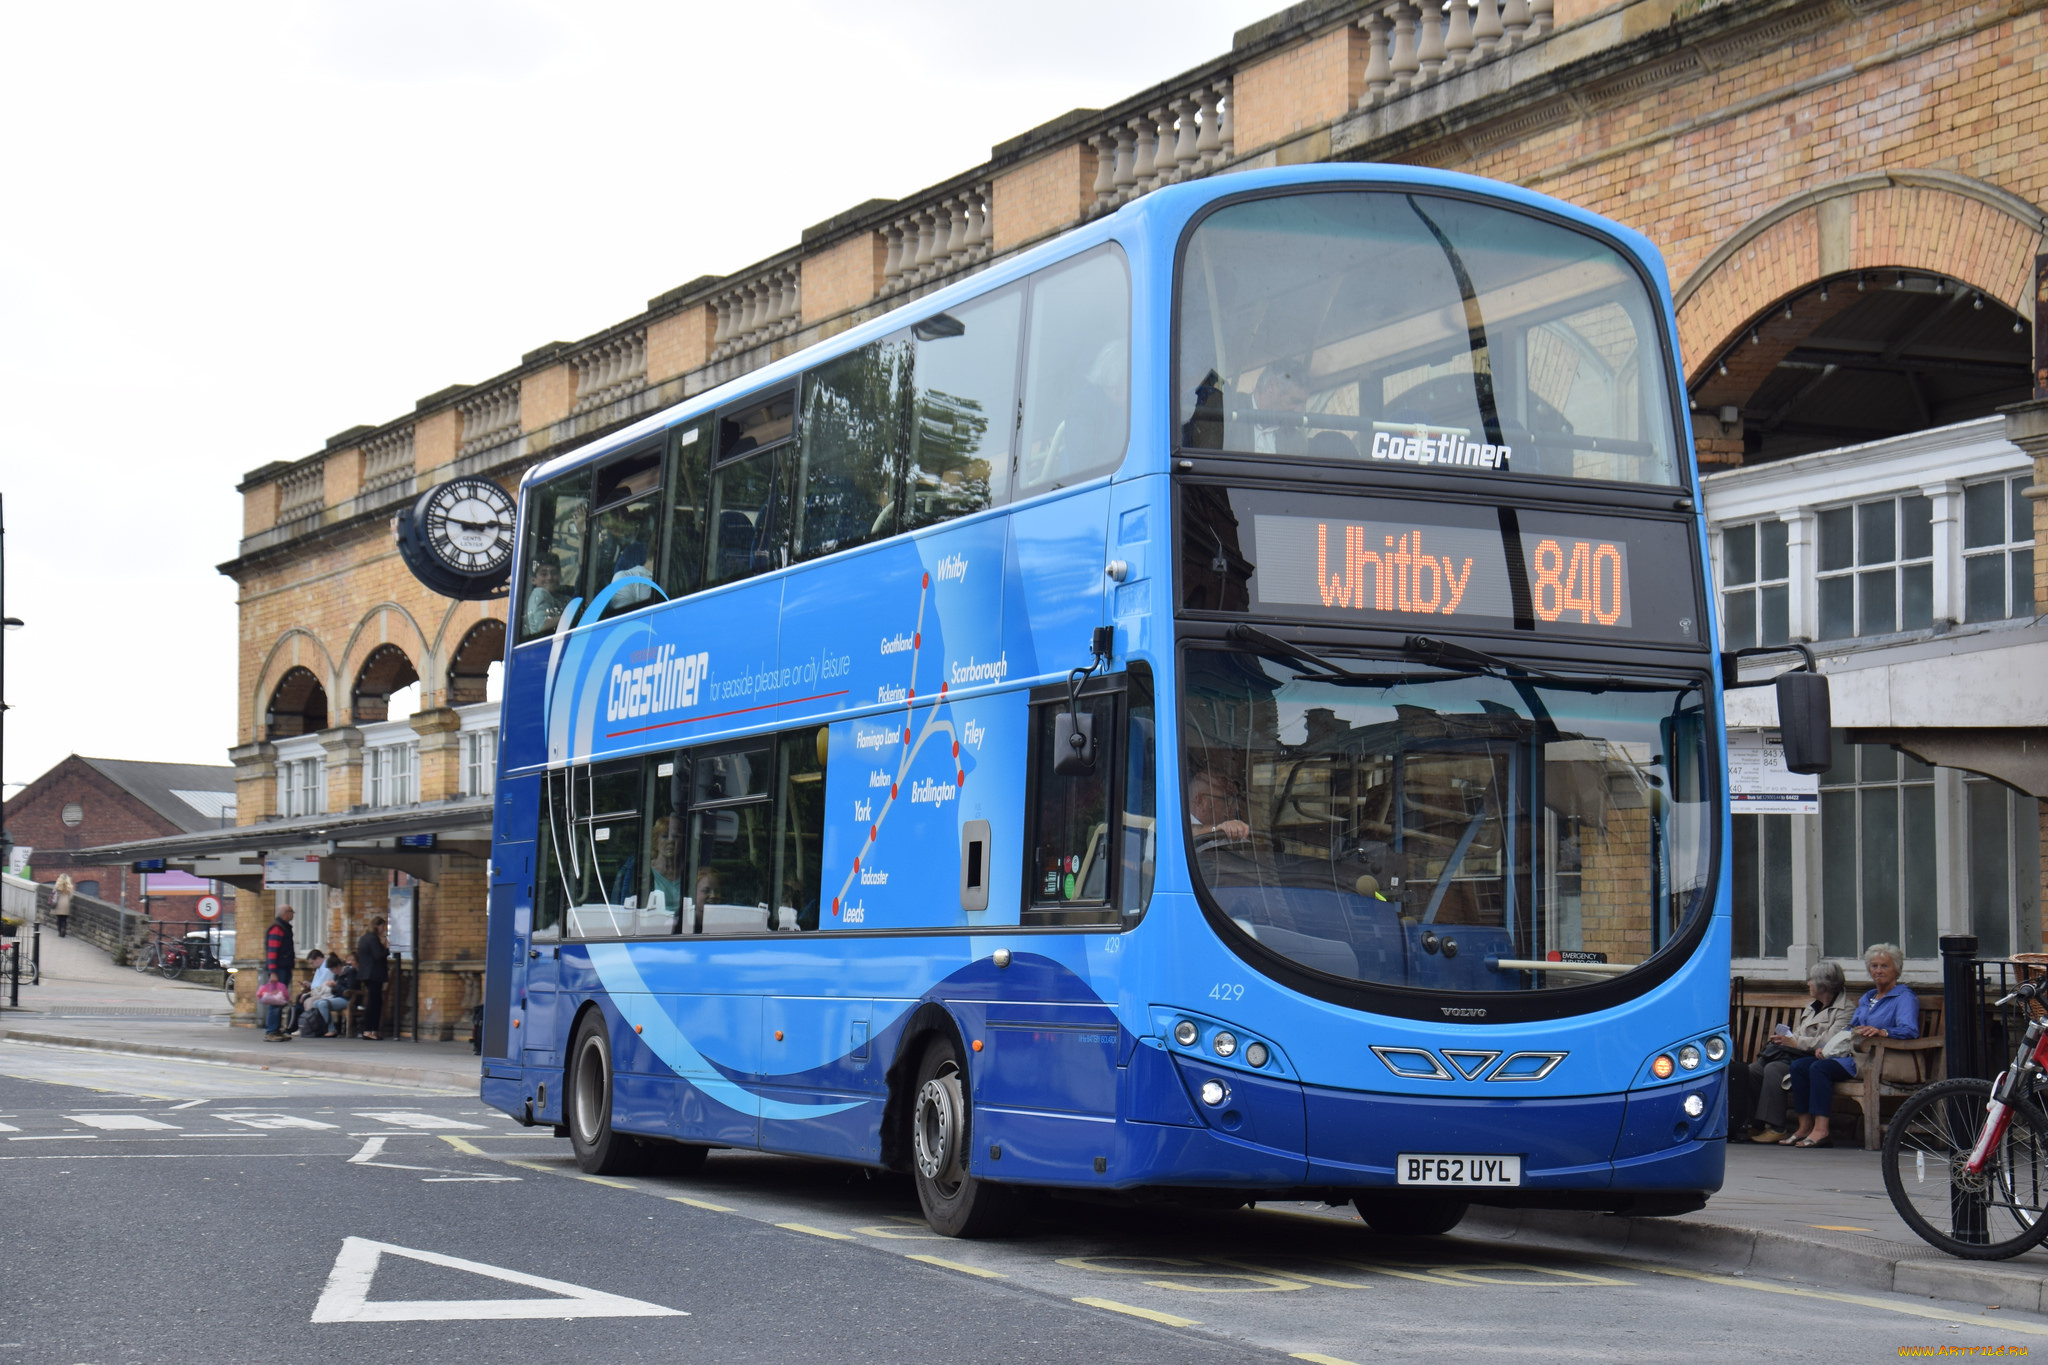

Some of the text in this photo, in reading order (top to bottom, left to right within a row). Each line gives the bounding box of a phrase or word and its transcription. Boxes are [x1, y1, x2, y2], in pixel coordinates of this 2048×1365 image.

[1371, 432, 1511, 468] Coastliner
[937, 552, 969, 583] Whitby
[1318, 523, 1621, 625] Whitby 840
[880, 630, 914, 655] Goathland
[951, 650, 1008, 685] Scarborough
[607, 643, 709, 722] Coastliner
[710, 671, 721, 702] for
[722, 664, 753, 700] seaside
[754, 661, 791, 702] pleasure
[792, 663, 803, 686] or
[804, 656, 820, 692] city
[821, 647, 850, 679] leisure
[878, 683, 906, 704] Pickering
[856, 724, 901, 751] Flamingo Land
[963, 719, 985, 750] Filey
[1763, 750, 1778, 758] 843
[1763, 758, 1778, 767] 845
[869, 768, 891, 788] Malton
[911, 777, 956, 808] Bridlington
[854, 797, 872, 822] York
[860, 866, 889, 886] Tadcaster
[205, 903, 212, 912] 5
[842, 899, 865, 923] Leeds
[1104, 936, 1120, 953] 429
[1562, 952, 1597, 960] EMERGENCY
[1208, 983, 1245, 1001] 429
[1441, 1007, 1487, 1017] VOLVO
[1407, 1158, 1511, 1182] BF62 UYL
